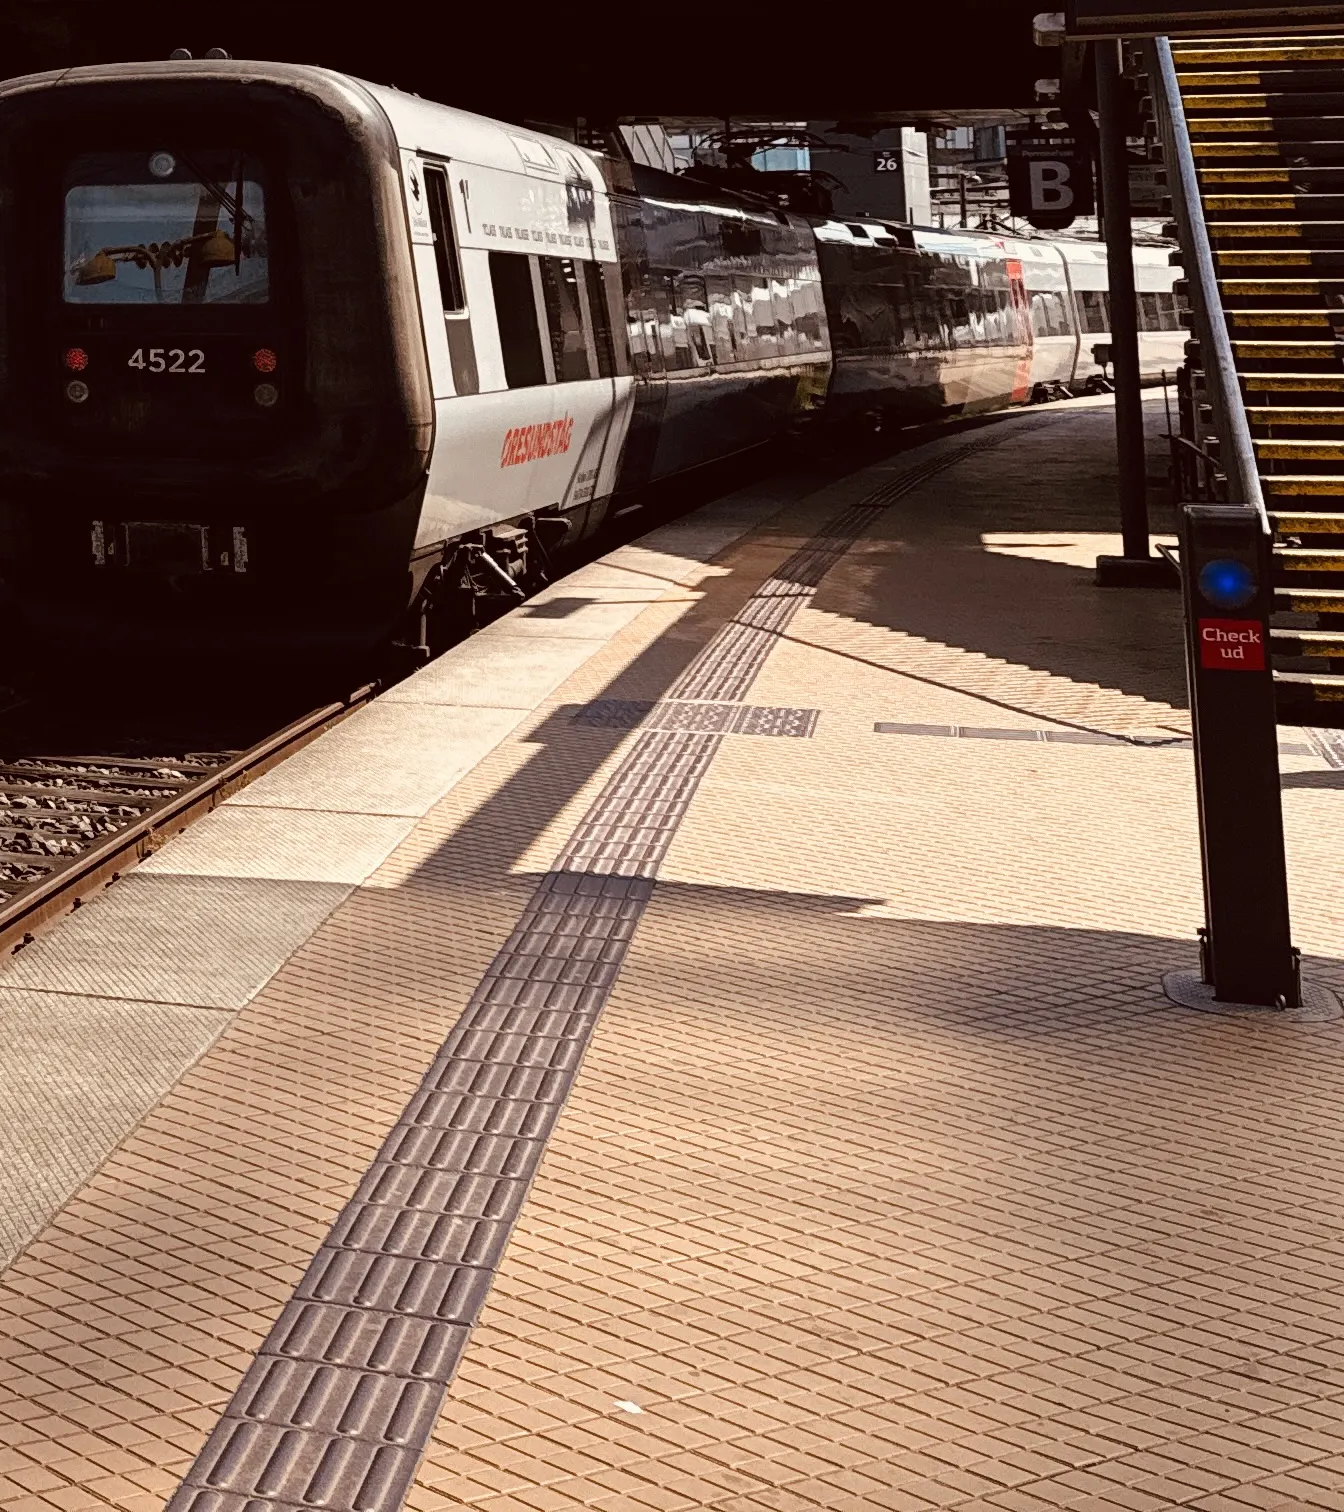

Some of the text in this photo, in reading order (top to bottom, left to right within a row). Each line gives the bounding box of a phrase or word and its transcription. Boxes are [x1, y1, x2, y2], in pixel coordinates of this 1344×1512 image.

[876, 157, 898, 171] 26
[1029, 160, 1074, 210] B
[127, 348, 206, 373] 4522
[1202, 627, 1261, 644] Check
[1219, 645, 1245, 660] ud
